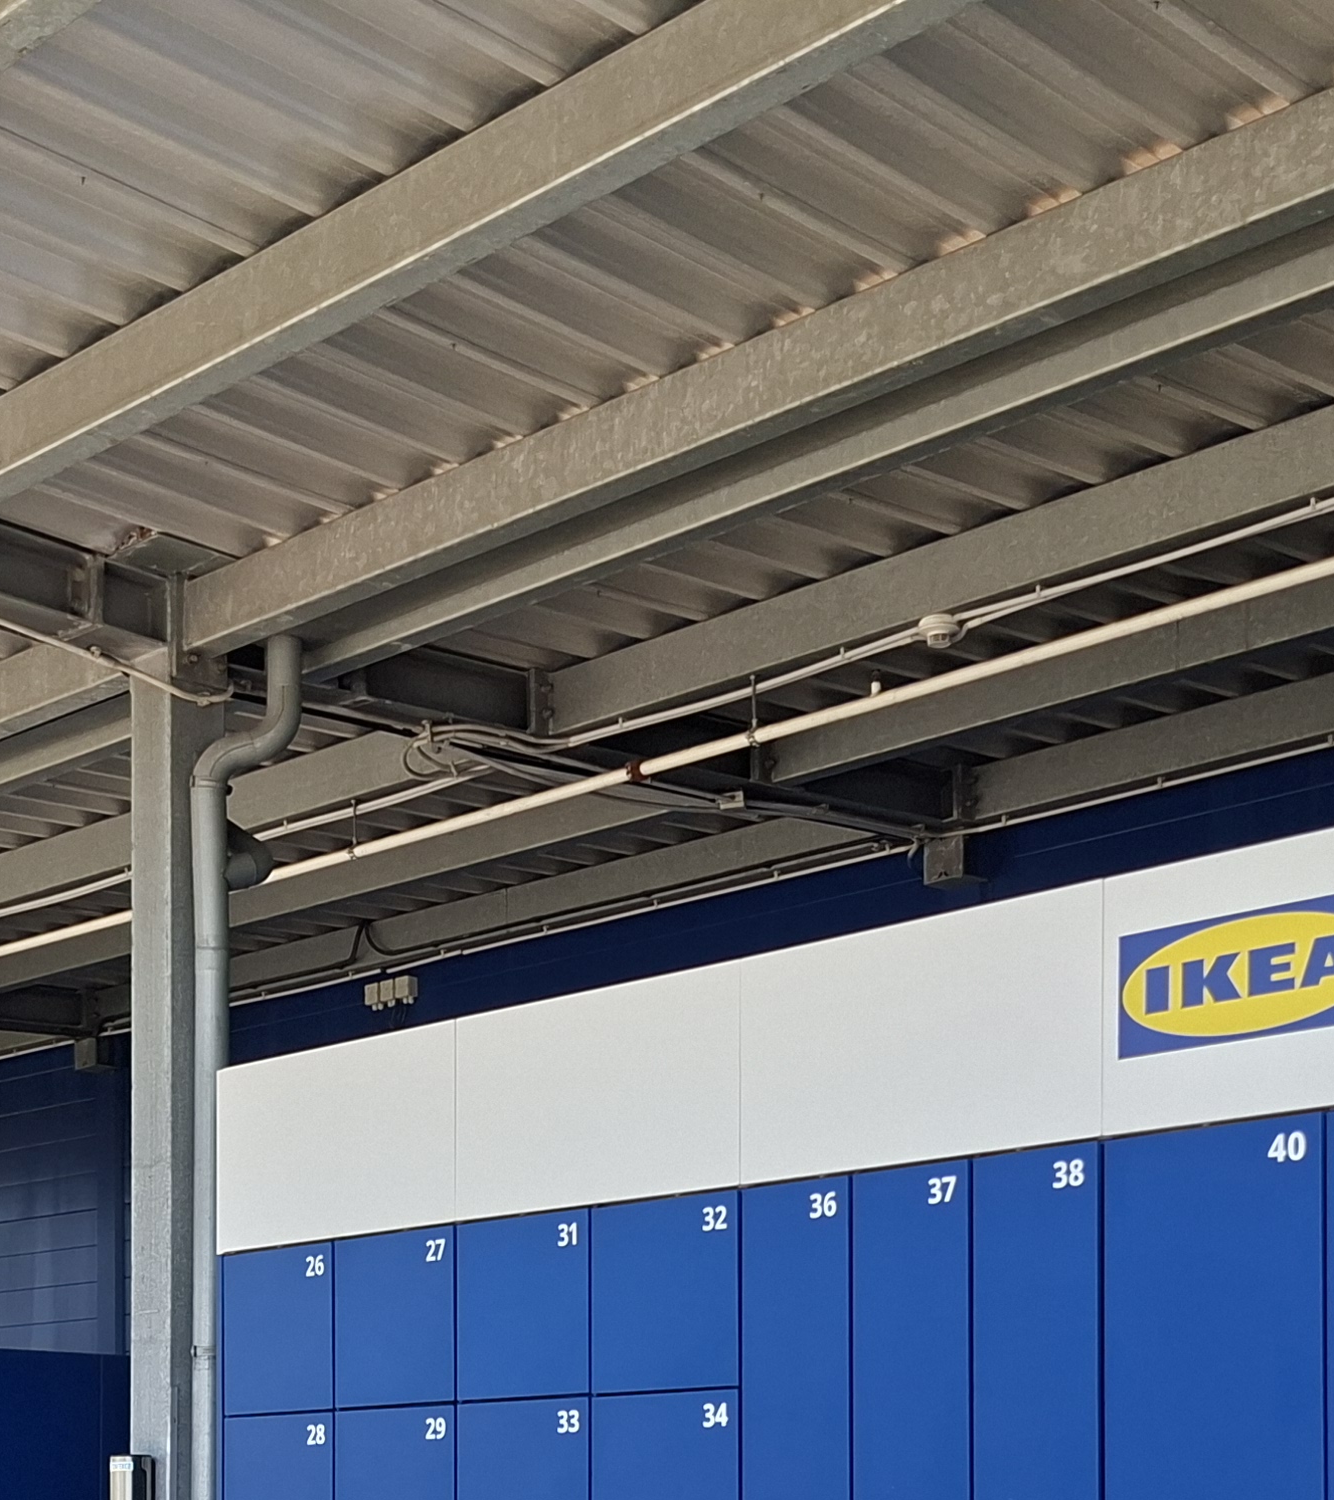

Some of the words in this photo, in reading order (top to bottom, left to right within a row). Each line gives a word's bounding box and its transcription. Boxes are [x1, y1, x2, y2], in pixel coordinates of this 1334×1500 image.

[1268, 1132, 1306, 1162] 40
[1053, 1159, 1084, 1188] 38
[928, 1176, 956, 1204] 37
[810, 1192, 836, 1218] 36
[703, 1206, 727, 1231] 32
[558, 1223, 576, 1246] 31
[426, 1239, 445, 1261] 27
[306, 1255, 324, 1276] 26
[558, 1410, 579, 1433] 33
[703, 1403, 728, 1427] 34
[307, 1424, 325, 1445] 28
[426, 1418, 445, 1439] 29
